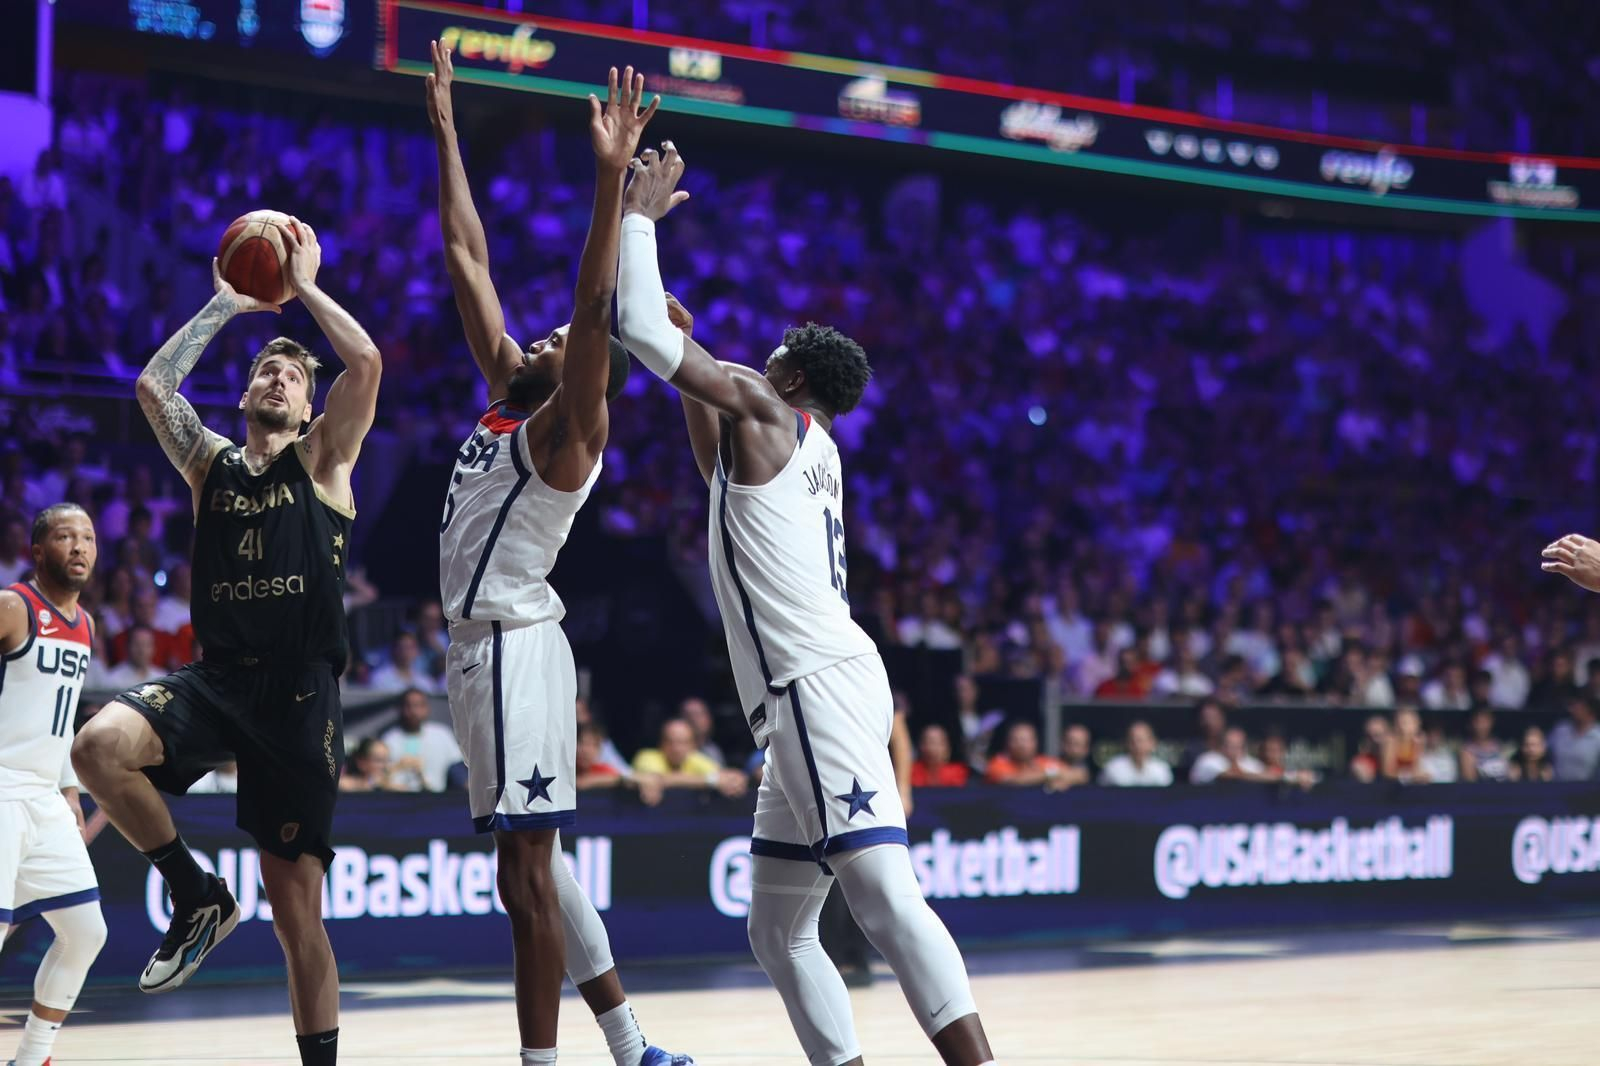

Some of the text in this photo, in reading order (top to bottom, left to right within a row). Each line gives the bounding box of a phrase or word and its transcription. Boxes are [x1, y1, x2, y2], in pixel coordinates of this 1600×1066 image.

[237, 527, 264, 561] 41
[210, 574, 305, 602] endesa
[51, 685, 73, 738] 11
[1154, 815, 1454, 899] @USABasketball
